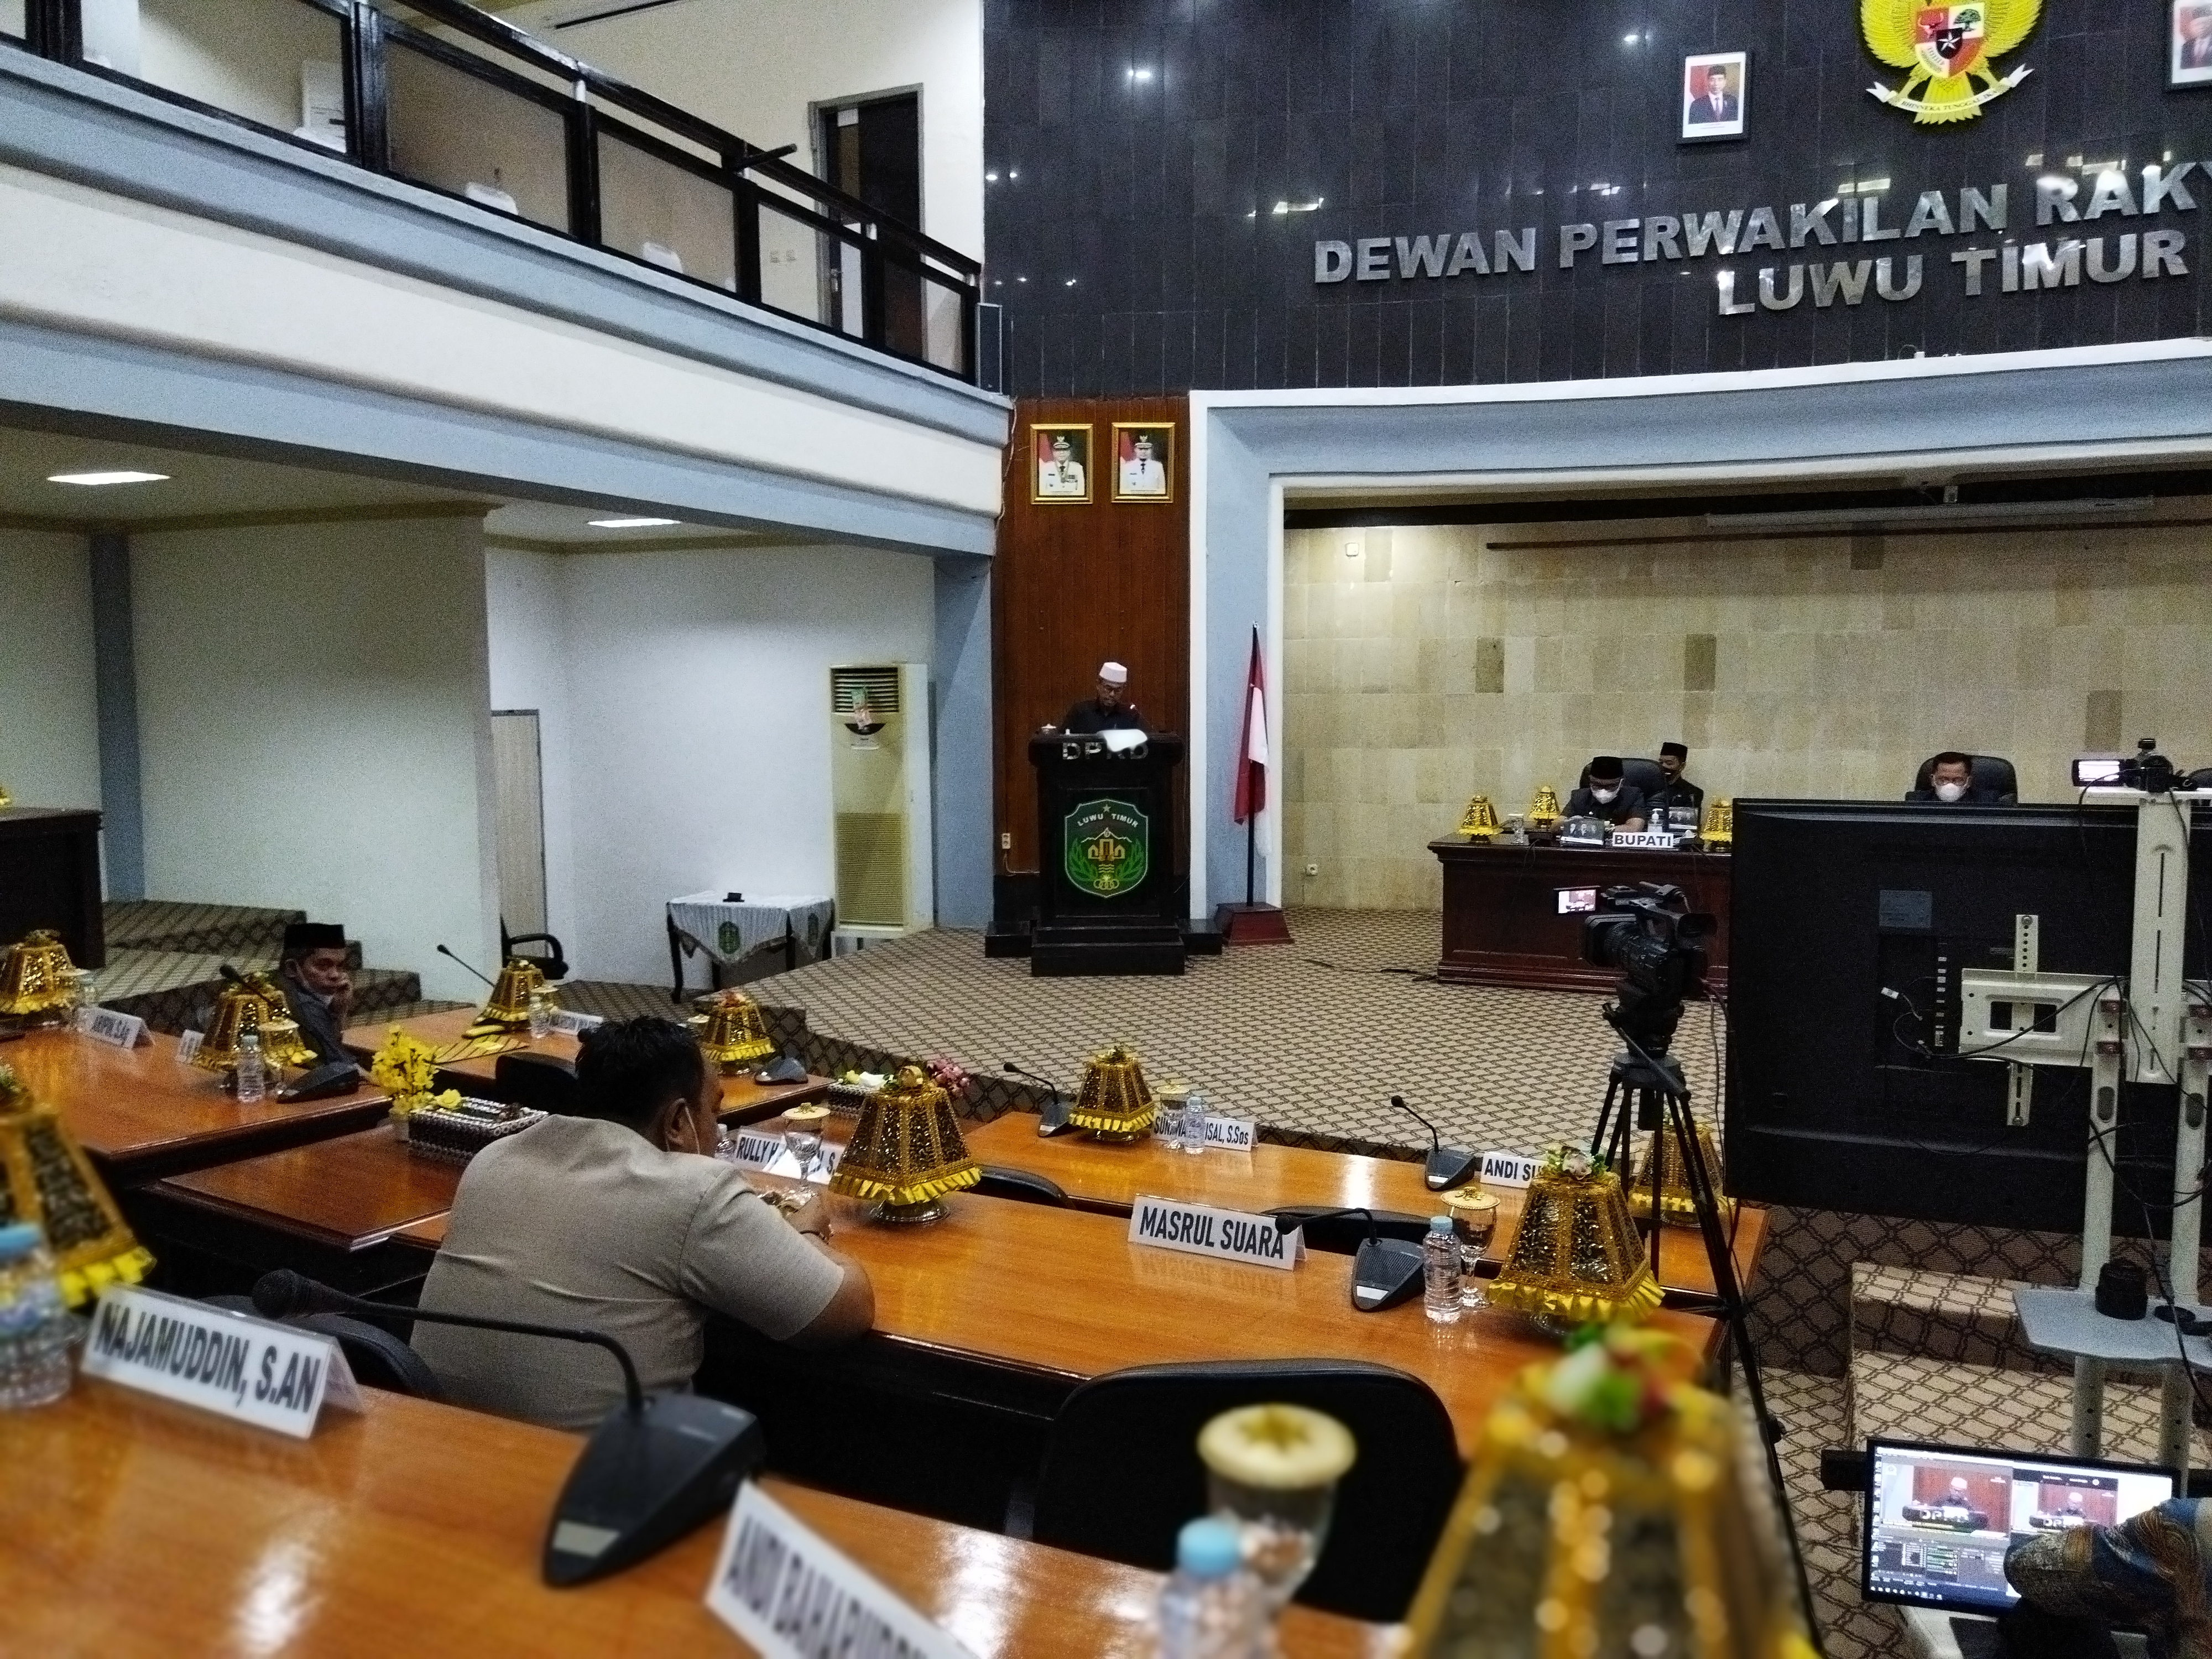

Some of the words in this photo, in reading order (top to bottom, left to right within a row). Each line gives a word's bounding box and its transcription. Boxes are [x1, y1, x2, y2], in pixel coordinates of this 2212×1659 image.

[1314, 227, 1536, 283] DEWAN
[1559, 183, 2008, 269] PERWAKILAN
[2036, 161, 2212, 226] RAK
[1717, 254, 1923, 316] LUWU
[1950, 229, 2190, 297] TIMUR
[1077, 813, 1104, 827] LUWU
[1111, 813, 1139, 828] TIMUR
[1614, 834, 1671, 846] BUPATI
[1227, 1125, 1249, 1145] S.Sos
[736, 1136, 770, 1163] RULLY
[1484, 1159, 1519, 1180] ANDI
[1139, 1206, 1214, 1248] MASRUL
[1220, 1219, 1284, 1259] SUARA
[93, 1302, 250, 1408] NAJAMUDDIN,
[255, 1345, 321, 1413] S.AN
